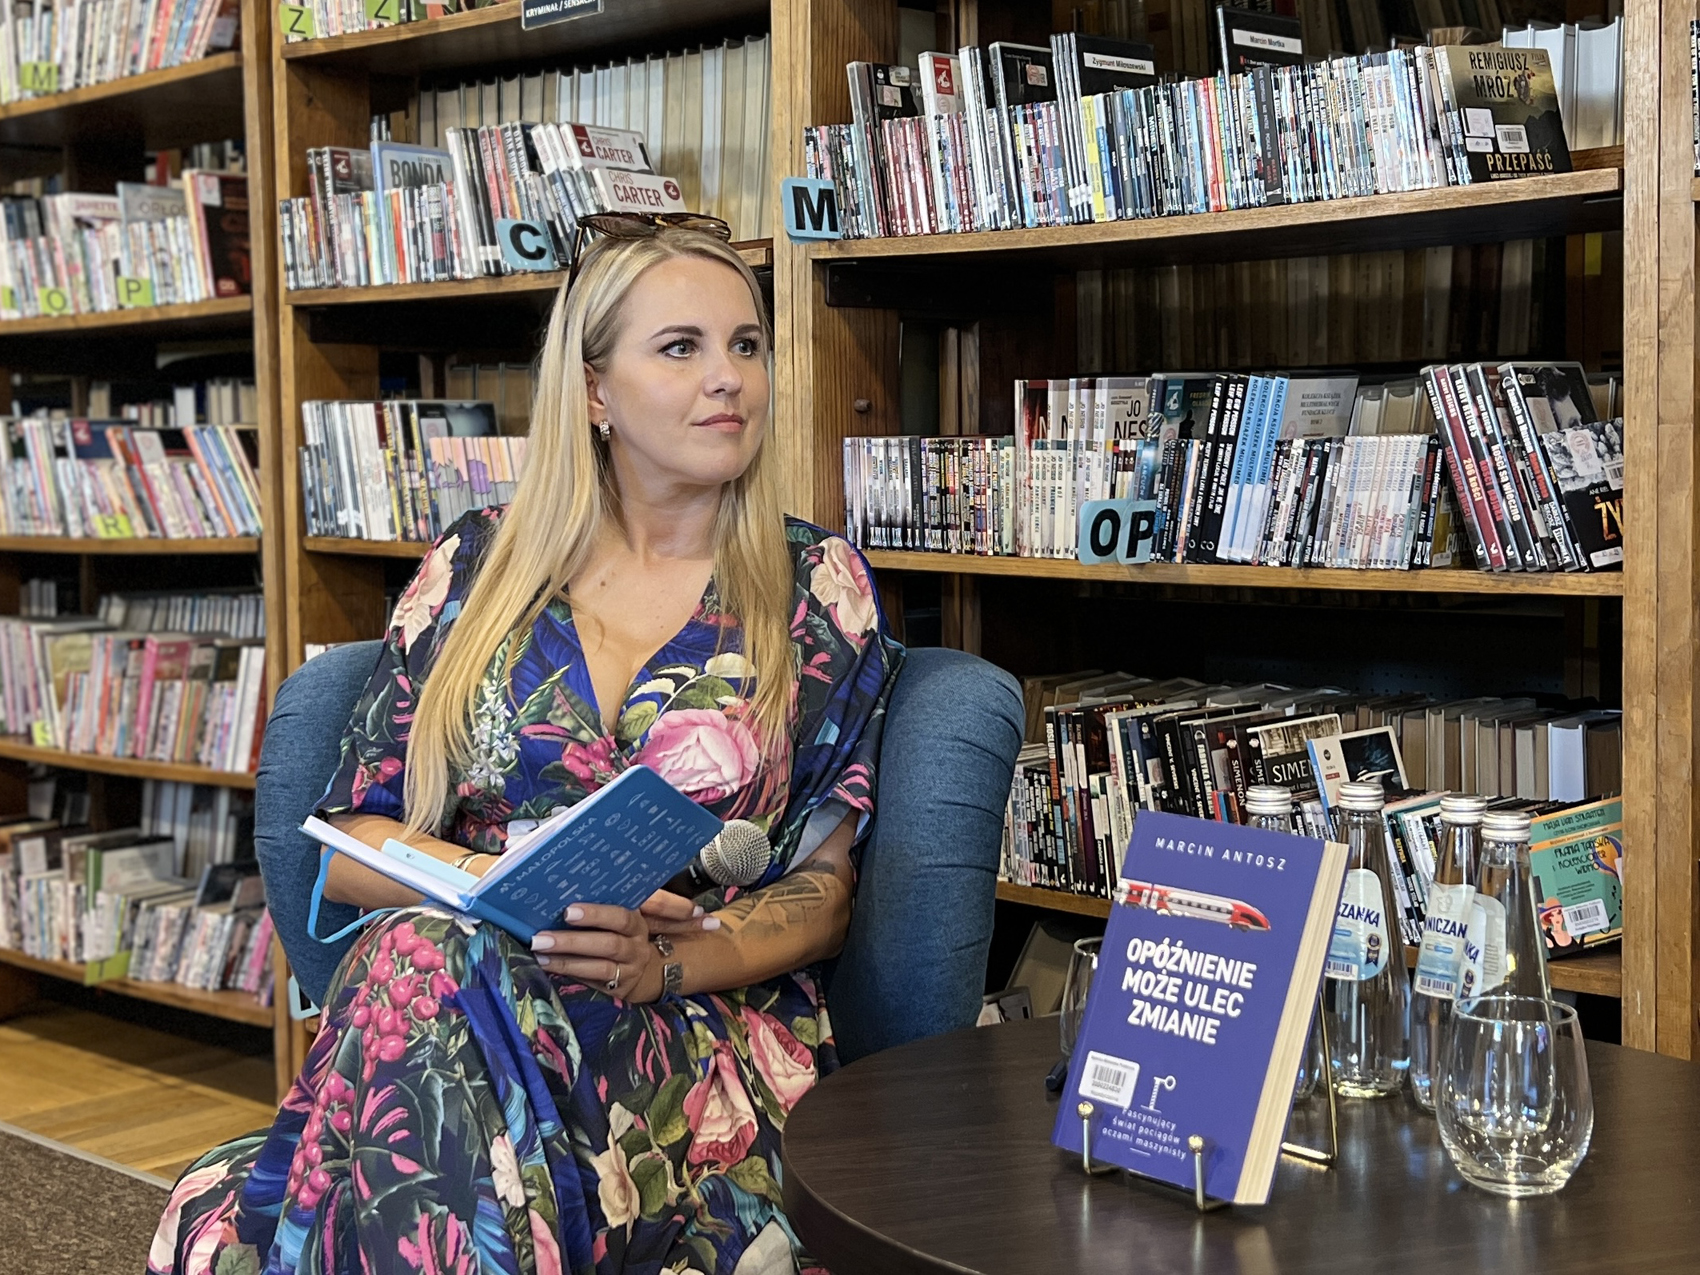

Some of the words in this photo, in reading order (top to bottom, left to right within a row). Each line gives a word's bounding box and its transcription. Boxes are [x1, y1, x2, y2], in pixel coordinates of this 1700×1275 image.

[288, 8, 306, 34] Z
[525, 2, 558, 18] KRYMINAŁ
[564, 0, 595, 9] SENSAC
[1469, 51, 1529, 71] REMIGIUSZ
[32, 68, 49, 87] M
[1473, 71, 1514, 98] MRÓZ
[592, 136, 612, 147] CHRIS
[596, 146, 635, 164] CARTER
[1486, 149, 1553, 172] PRZEPAŚĆ
[608, 171, 634, 185] CHRIS
[613, 184, 664, 207] CARTER
[792, 185, 839, 232] M
[509, 223, 547, 260] C
[47, 290, 67, 311] O
[126, 279, 141, 301] P
[1211, 396, 1219, 409] GW
[1213, 382, 1222, 397] LEIF
[1227, 383, 1235, 398] LEIF
[1234, 383, 1243, 398] LEIF
[1246, 378, 1258, 414] KOLEKCJA
[1257, 380, 1270, 416] KOLEKCJA
[1272, 380, 1284, 416] KOLEKCJA
[1506, 386, 1523, 415] Zamach
[1127, 399, 1141, 417] JO
[1225, 398, 1233, 410] GW
[1232, 398, 1241, 410] GW
[1428, 395, 1443, 420] REICHS
[1443, 393, 1458, 417] REICHS
[1453, 378, 1469, 404] KATHY
[1461, 403, 1479, 438] REICHS
[1114, 420, 1148, 439] NES
[1207, 408, 1217, 434] PERSSON
[1220, 410, 1231, 436] PERSSON
[1227, 410, 1239, 436] PERSSON
[1239, 415, 1251, 446] KSIĄŻEK
[1251, 417, 1263, 448] KSIĄŻEK
[1265, 417, 1277, 449] KSIĄŻEK
[1478, 410, 1494, 435] REICHS
[1244, 449, 1256, 484] MULTIME
[1258, 450, 1271, 484] MULTIME
[1462, 457, 1475, 476] 206
[1467, 475, 1484, 501] kości
[1489, 443, 1508, 471] kości
[1500, 481, 1523, 522] wieczne
[1542, 502, 1555, 527] REKOSZ
[1548, 500, 1561, 526] DARIUSZ
[1594, 496, 1623, 541] ŻY
[1090, 508, 1121, 557] O
[1126, 510, 1154, 559] P
[1045, 722, 1056, 758] ROSLUND
[1163, 732, 1173, 757] VINCENT
[1168, 763, 1179, 790] SEVERSKI
[1196, 743, 1211, 780] FABRYKA
[1253, 758, 1265, 785] SIME
[1049, 759, 1059, 800] THUNBERG
[1189, 767, 1200, 793] VINCENT
[1230, 758, 1247, 806] SIMENON
[515, 816, 598, 881] MAŁOPOLSKA
[1155, 836, 1215, 858] MARCIN
[1221, 848, 1287, 871] ANTOSZ
[1338, 902, 1380, 927] ZANKA
[1126, 937, 1257, 989] OPÓŹNIENIE
[1121, 968, 1182, 1004] MOŻE
[1184, 982, 1244, 1018] ULEC
[1127, 999, 1221, 1045] ZMIANIE
[1112, 1116, 1136, 1130] świat
[1138, 1125, 1180, 1145] pociągów
[1121, 1107, 1176, 1131] Fascynujący
[1102, 1127, 1133, 1142] oczami
[1135, 1137, 1186, 1160] maszynisty
